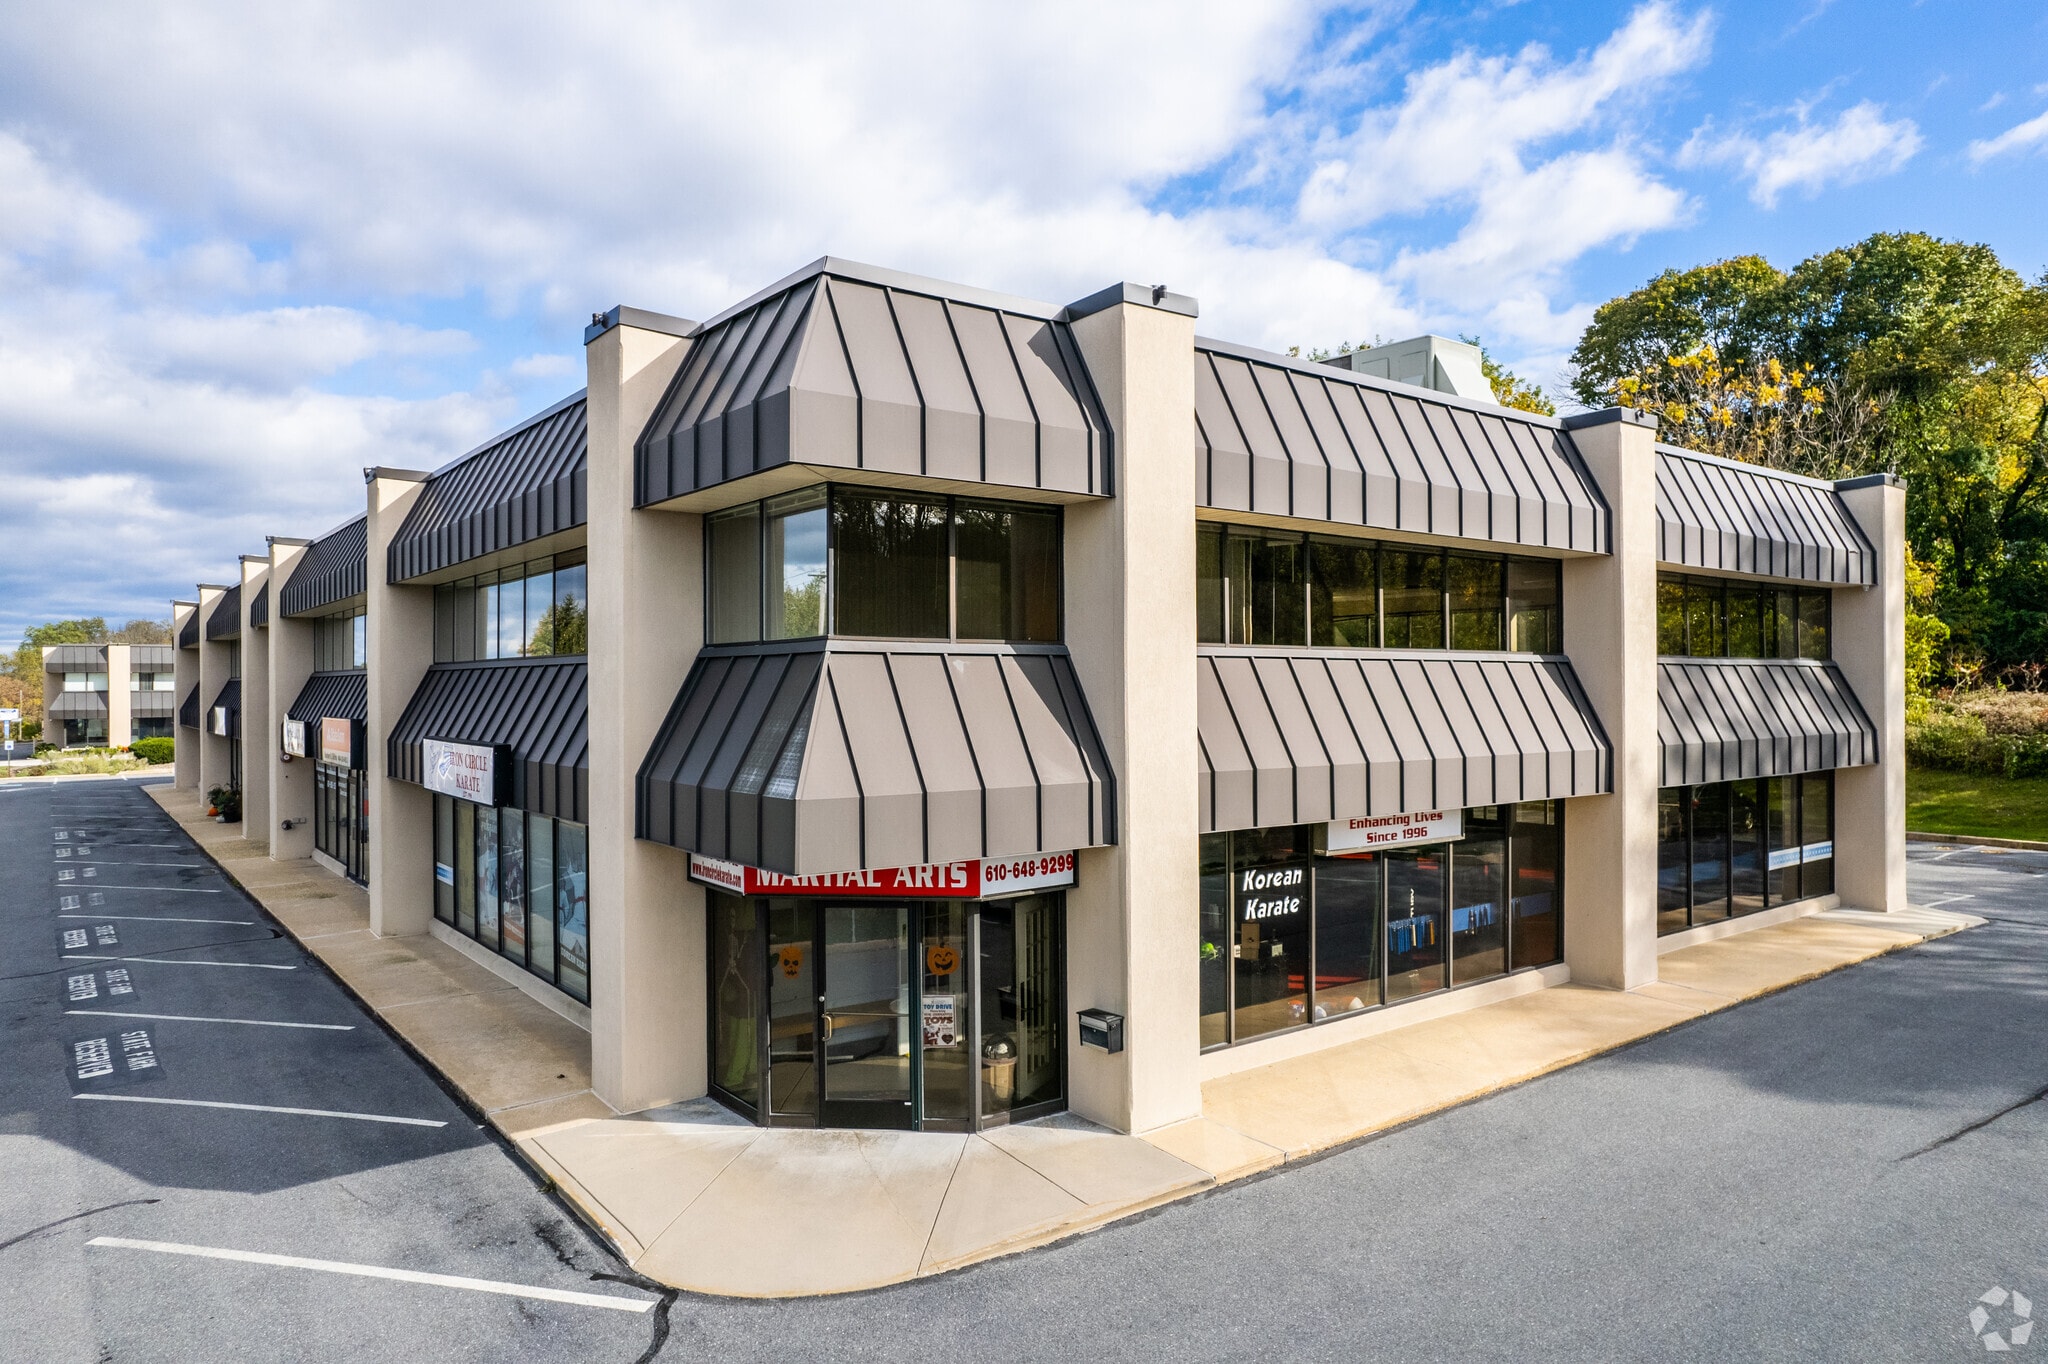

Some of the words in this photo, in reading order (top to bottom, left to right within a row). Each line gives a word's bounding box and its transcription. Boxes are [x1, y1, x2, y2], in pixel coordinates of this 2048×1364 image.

[465, 753, 487, 771] CIRCLE
[456, 773, 480, 792] KARATE
[1349, 815, 1410, 830] Enhancing
[1415, 812, 1443, 823] Lives
[1366, 832, 1398, 844] Since
[1402, 827, 1428, 840] 1996
[893, 863, 967, 888] ARTS
[985, 853, 1074, 882] 610-648-9299
[1243, 869, 1303, 891] Korean
[1245, 896, 1300, 920] Karate
[924, 1016, 953, 1026] TOYS
